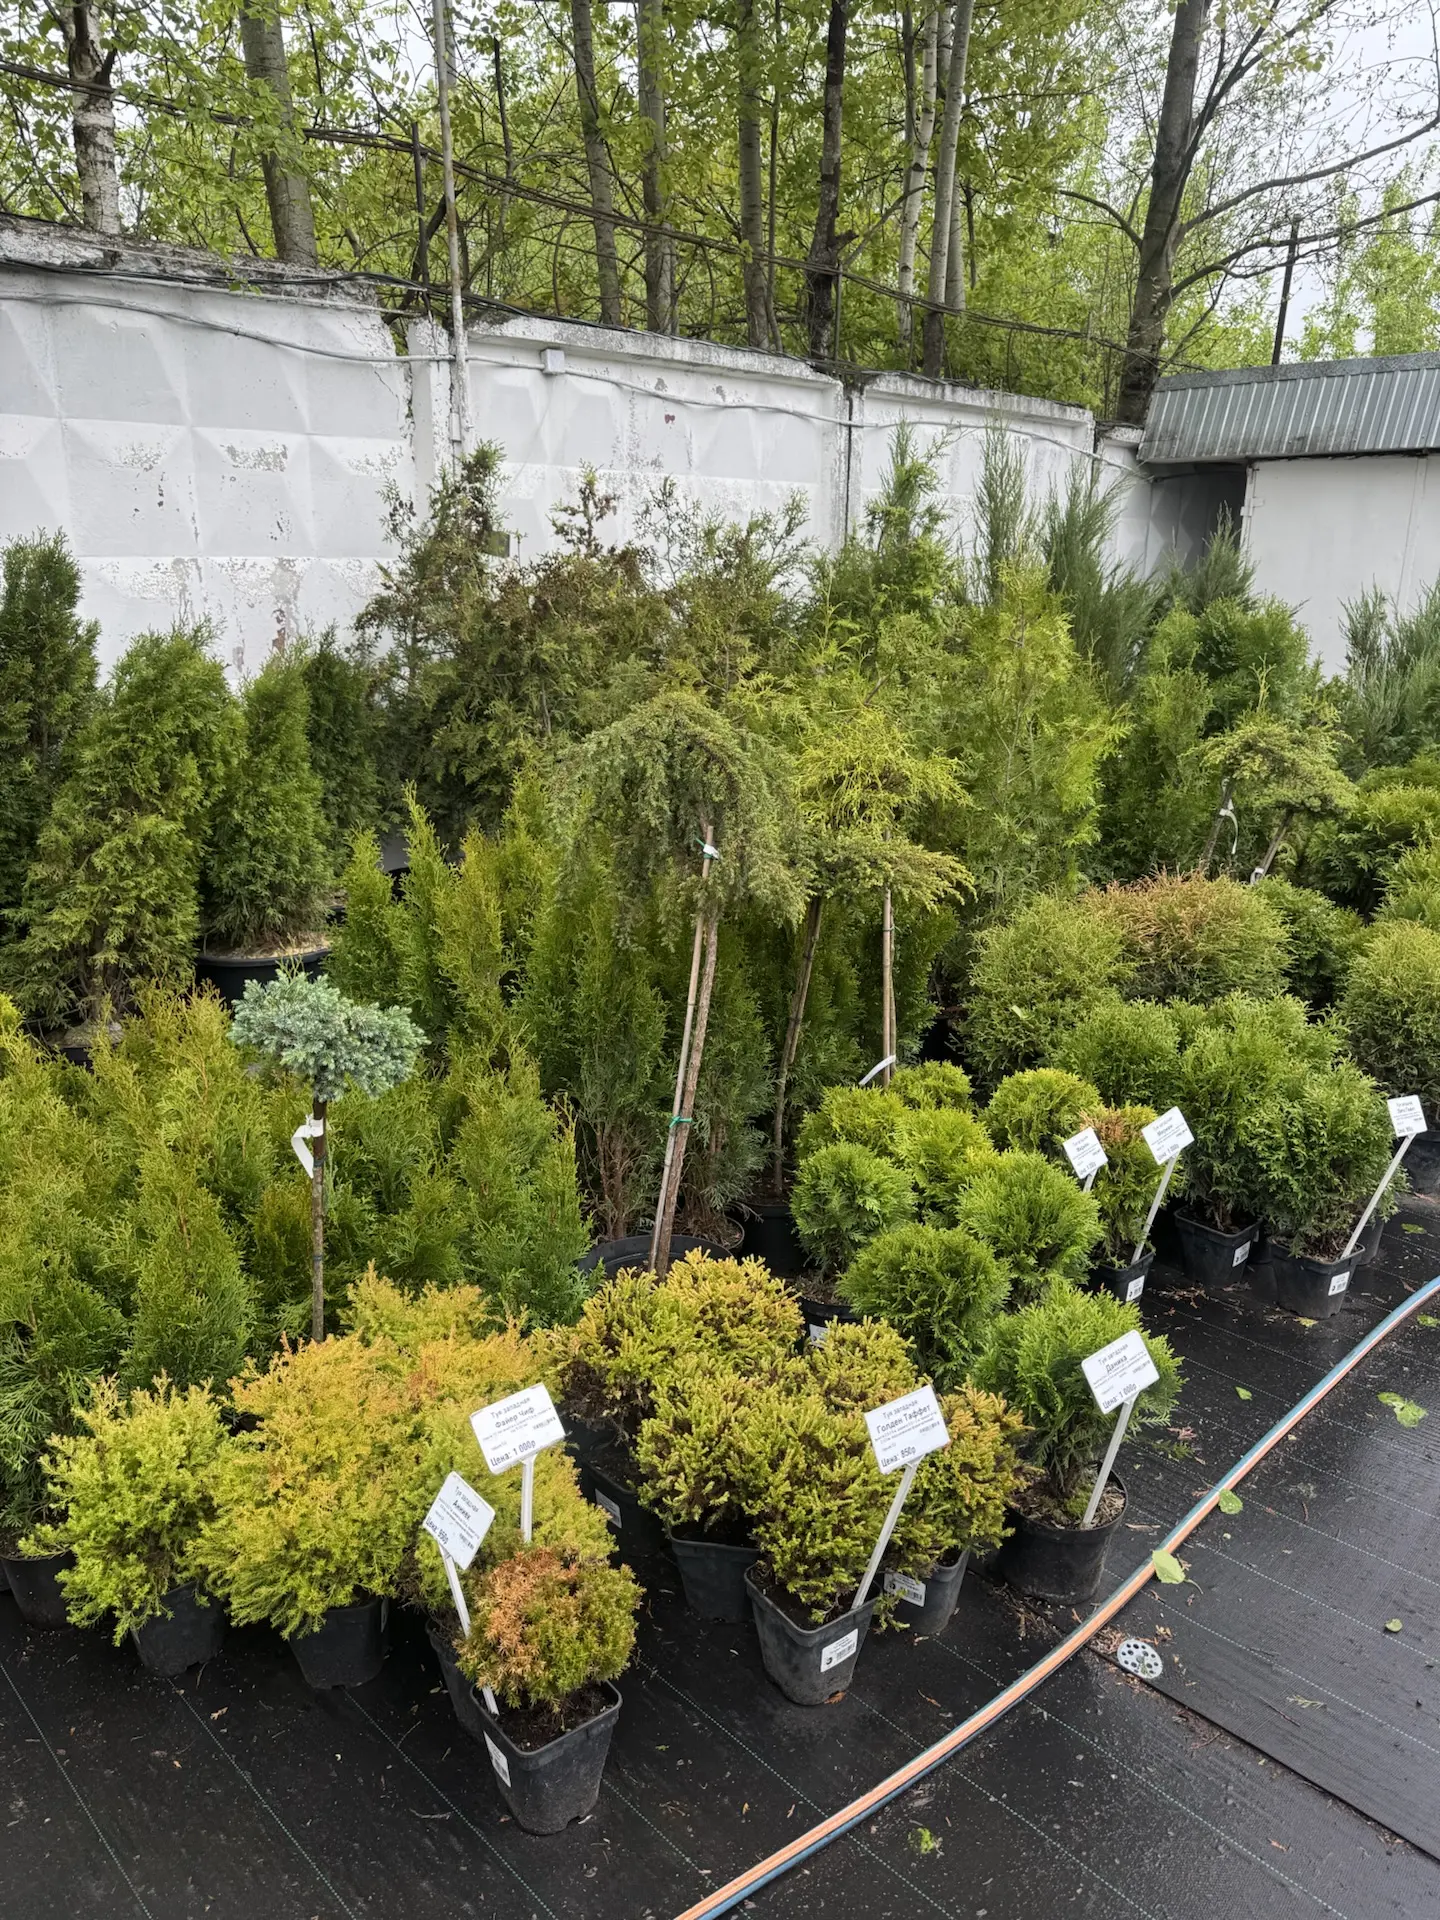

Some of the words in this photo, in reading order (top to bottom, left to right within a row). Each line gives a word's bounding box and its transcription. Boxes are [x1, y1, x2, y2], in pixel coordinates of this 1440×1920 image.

[1107, 1344, 1128, 1360] западная
[1105, 1355, 1128, 1373] Даника
[504, 1397, 530, 1413] западная
[894, 1400, 918, 1414] западная
[1102, 1395, 1119, 1409] Цена:
[495, 1414, 518, 1428] Файер
[518, 1407, 535, 1417] Чиф
[876, 1419, 903, 1434] Голден
[903, 1405, 930, 1421] Таффет
[490, 1452, 512, 1467] Цена:
[518, 1440, 536, 1453] 000р
[881, 1454, 900, 1467] Цена:
[900, 1446, 916, 1458] 850р
[426, 1516, 438, 1533] Цена:
